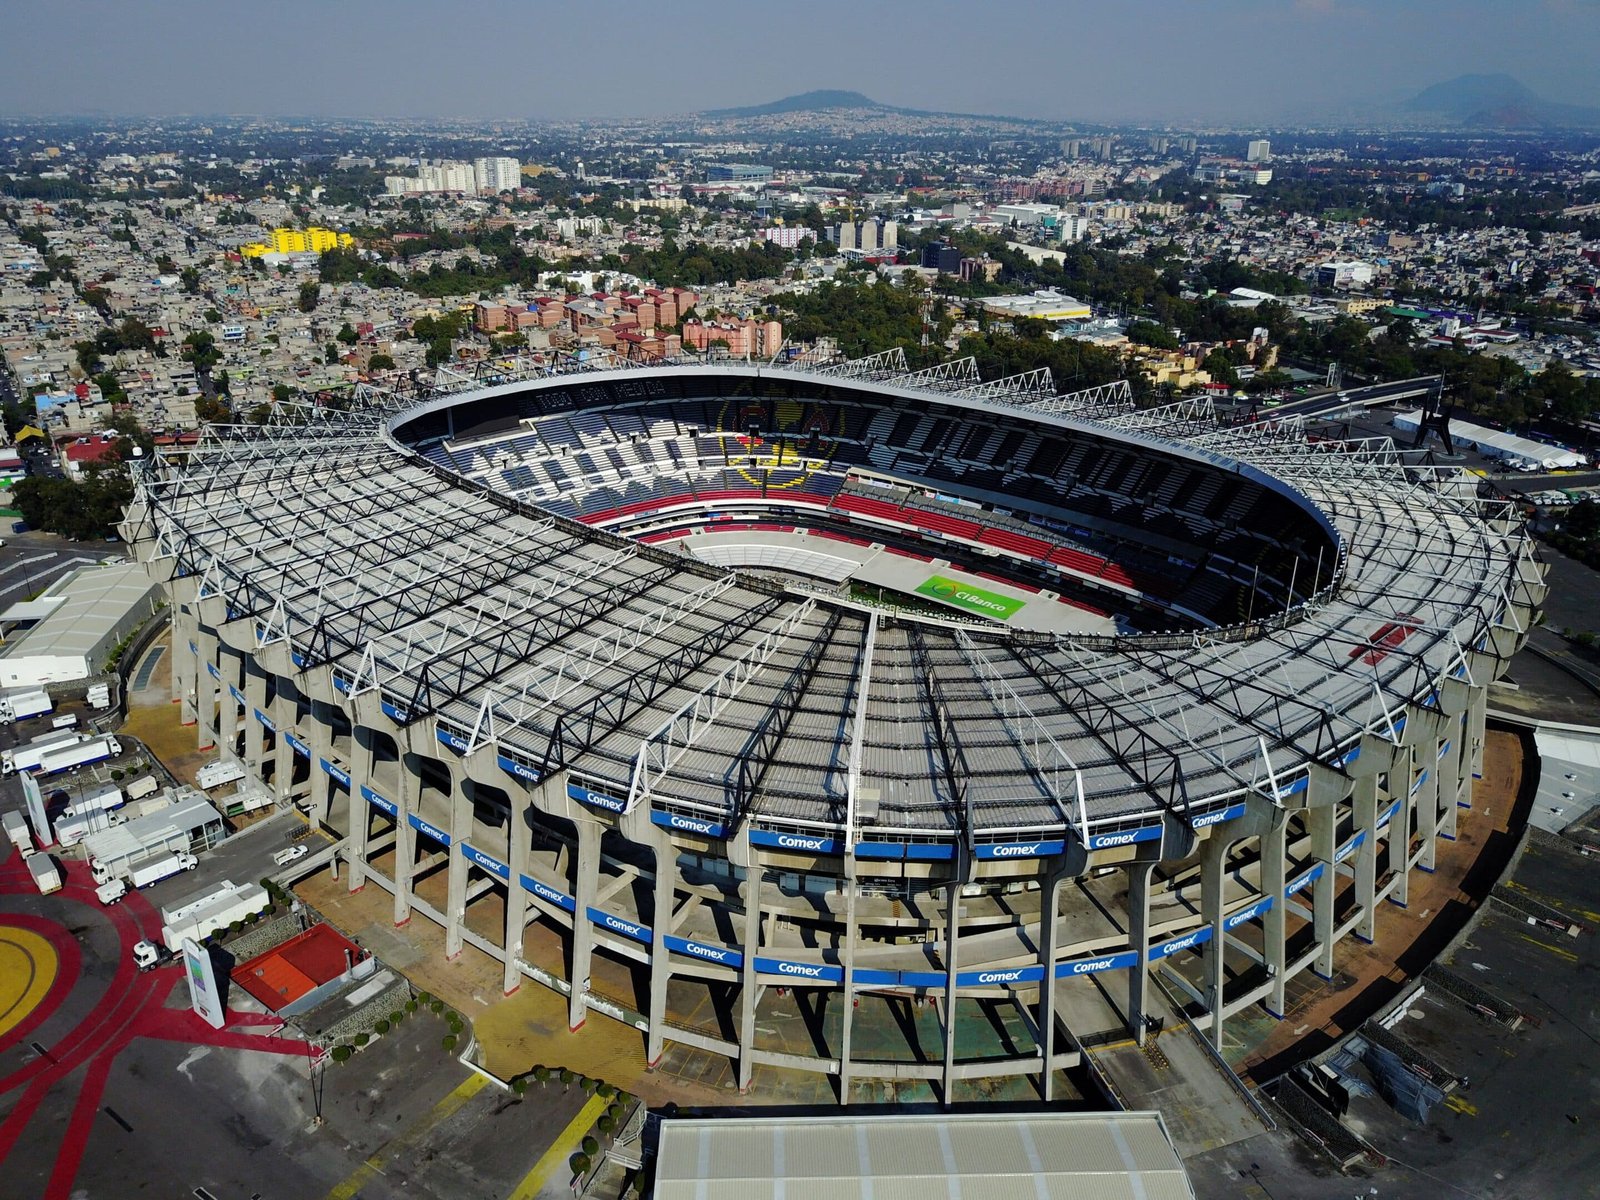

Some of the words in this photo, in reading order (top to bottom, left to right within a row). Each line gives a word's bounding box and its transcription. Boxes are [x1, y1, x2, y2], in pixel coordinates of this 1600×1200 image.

[329, 766, 349, 782] Comex
[514, 765, 539, 782] Come
[371, 793, 395, 812] Comex
[588, 793, 625, 811] Comex
[671, 816, 713, 834] Comex
[1190, 810, 1229, 829] Comex
[420, 823, 446, 842] Comex
[1095, 831, 1139, 848] Comex
[778, 835, 827, 850] Comex
[993, 843, 1041, 857] Comex
[475, 852, 502, 872] Comex
[1288, 872, 1312, 894] Comex
[534, 883, 564, 903] Comex
[1229, 904, 1260, 926] Comex
[606, 916, 641, 936] Comex
[687, 943, 728, 961] Comex
[1163, 933, 1199, 953] Comex
[778, 963, 823, 977] Comex
[1073, 957, 1116, 973] Comex
[979, 970, 1024, 983] Comex
